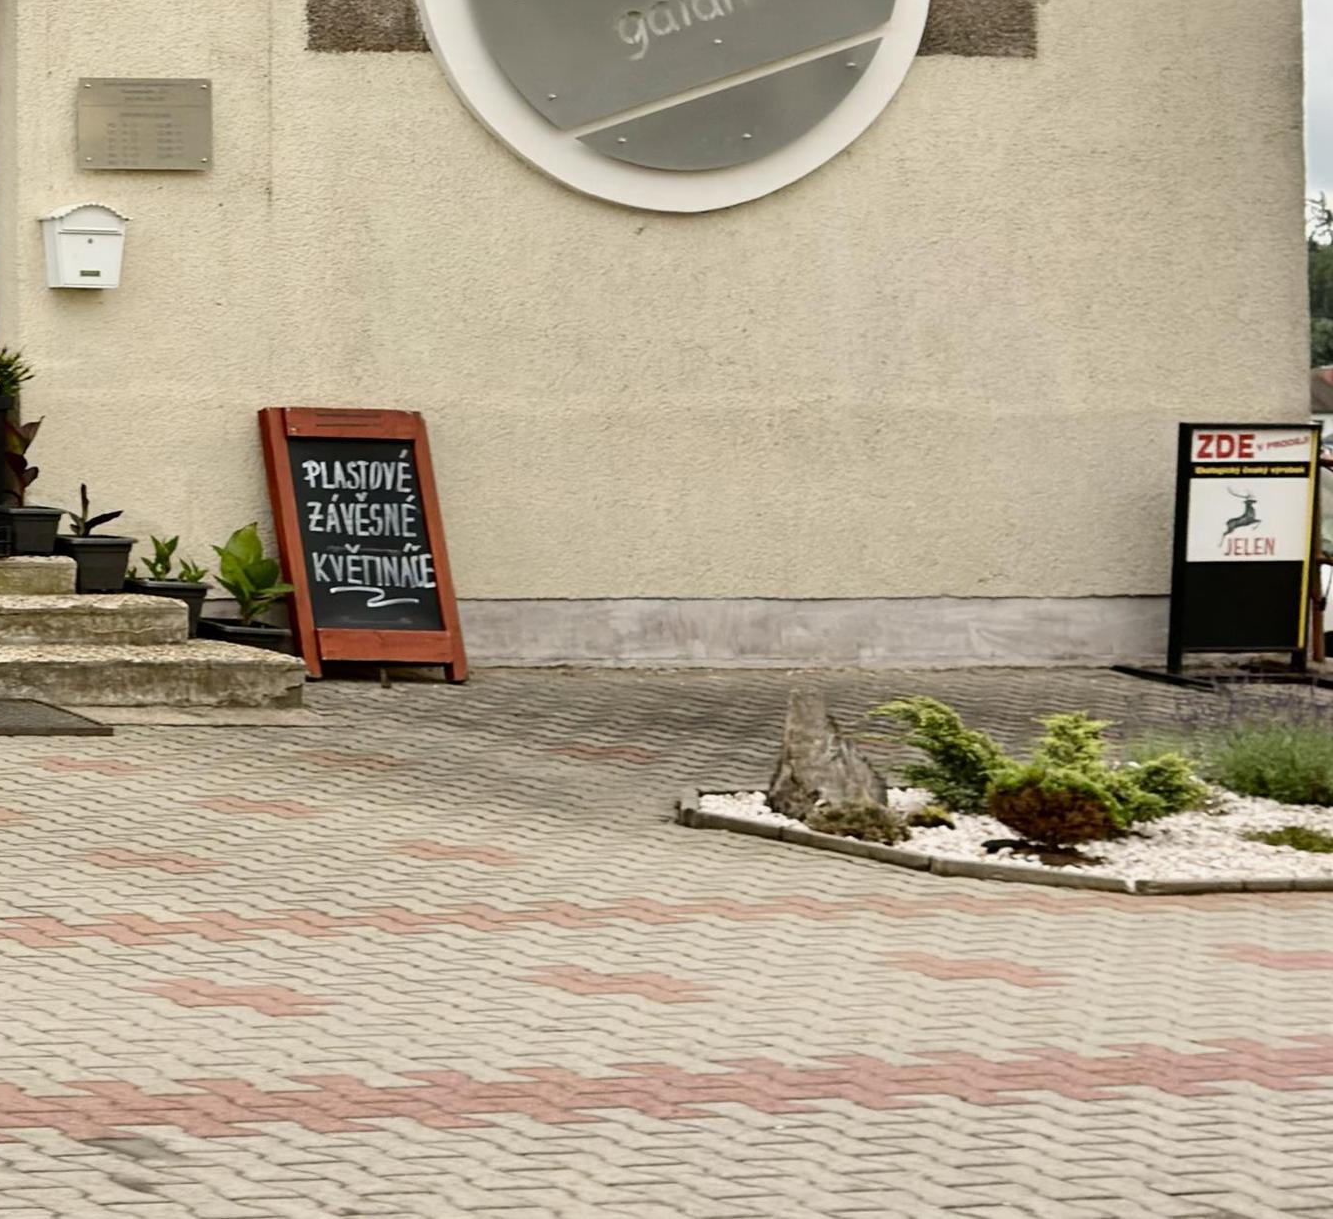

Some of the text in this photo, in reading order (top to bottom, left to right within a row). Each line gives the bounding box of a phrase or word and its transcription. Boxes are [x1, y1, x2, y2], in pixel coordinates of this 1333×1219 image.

[1196, 433, 1256, 459] ZDE
[302, 449, 413, 493] PLASTOVÉ
[307, 492, 418, 537] ZÁVĚSNÉ
[1224, 537, 1277, 557] JELEN
